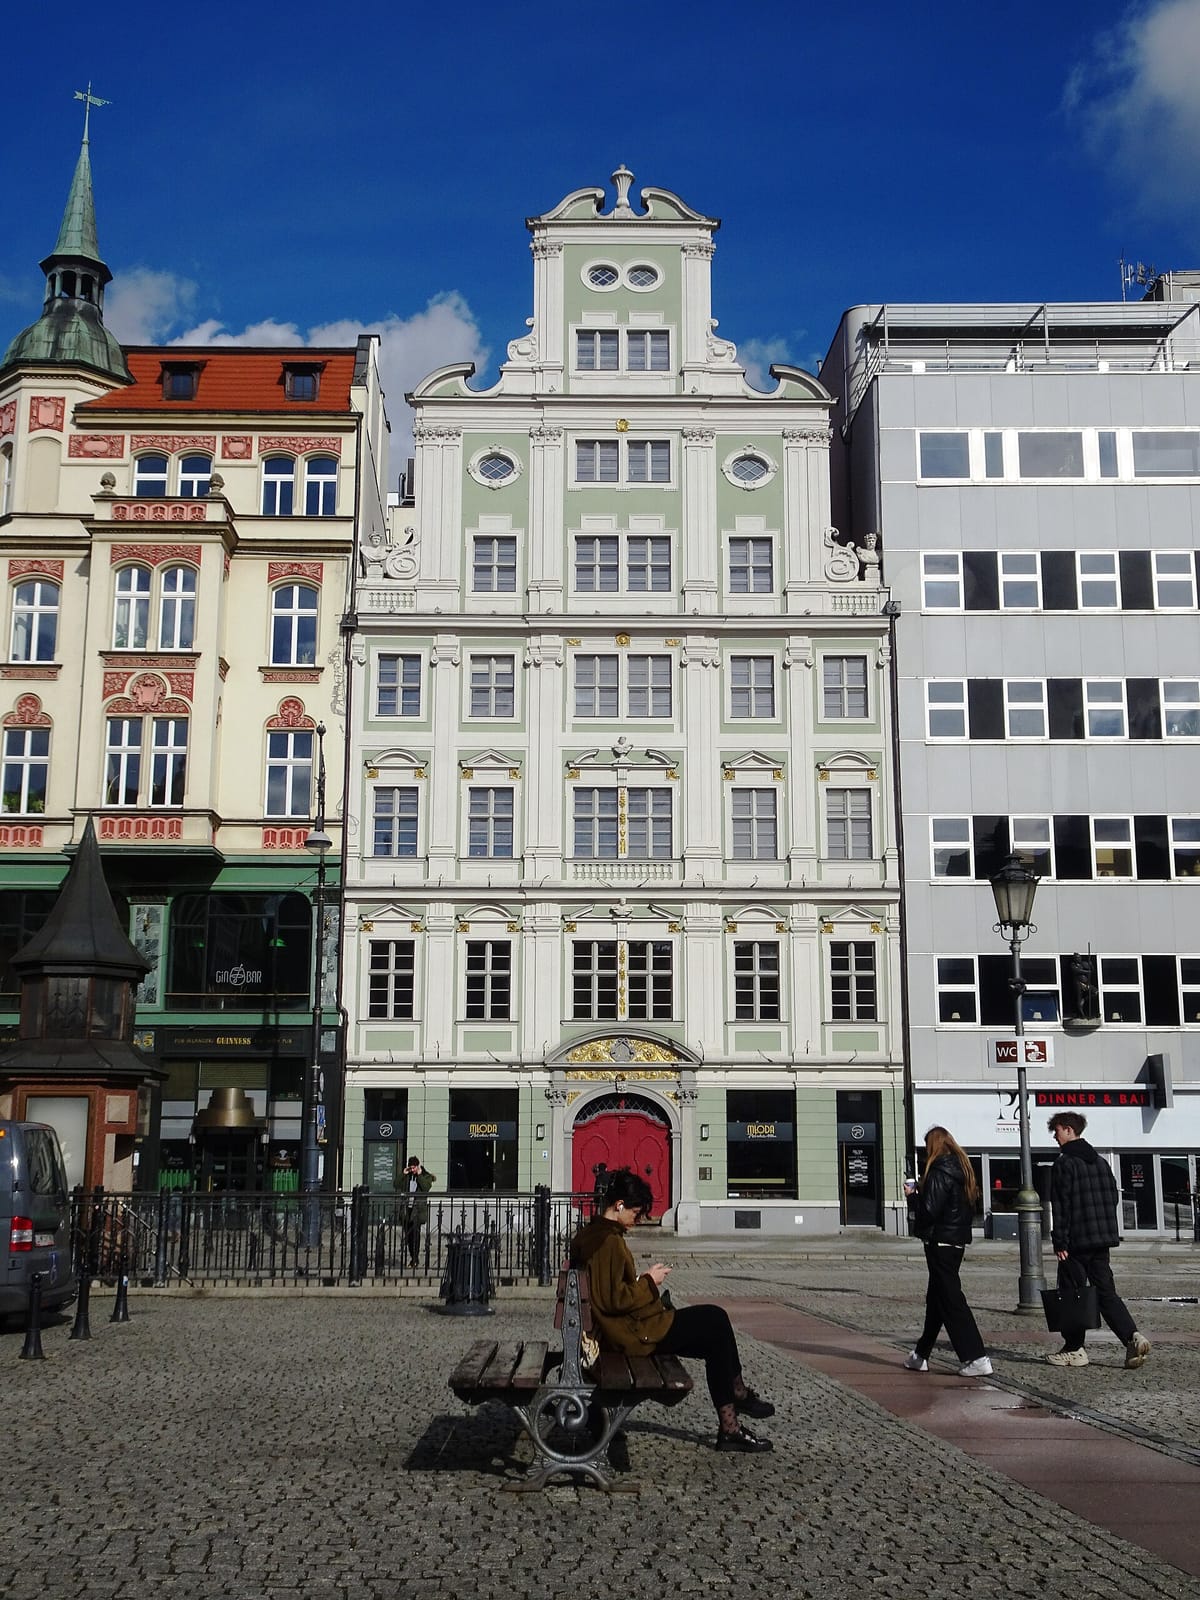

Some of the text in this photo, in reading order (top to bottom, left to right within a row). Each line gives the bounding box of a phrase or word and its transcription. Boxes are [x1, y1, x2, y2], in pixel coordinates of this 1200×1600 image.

[246, 970, 262, 983] BAR
[216, 1036, 252, 1045] GUINNESS
[996, 1046, 1017, 1057] WC
[1037, 1093, 1096, 1105] DINNER
[1103, 1094, 1112, 1105] &
